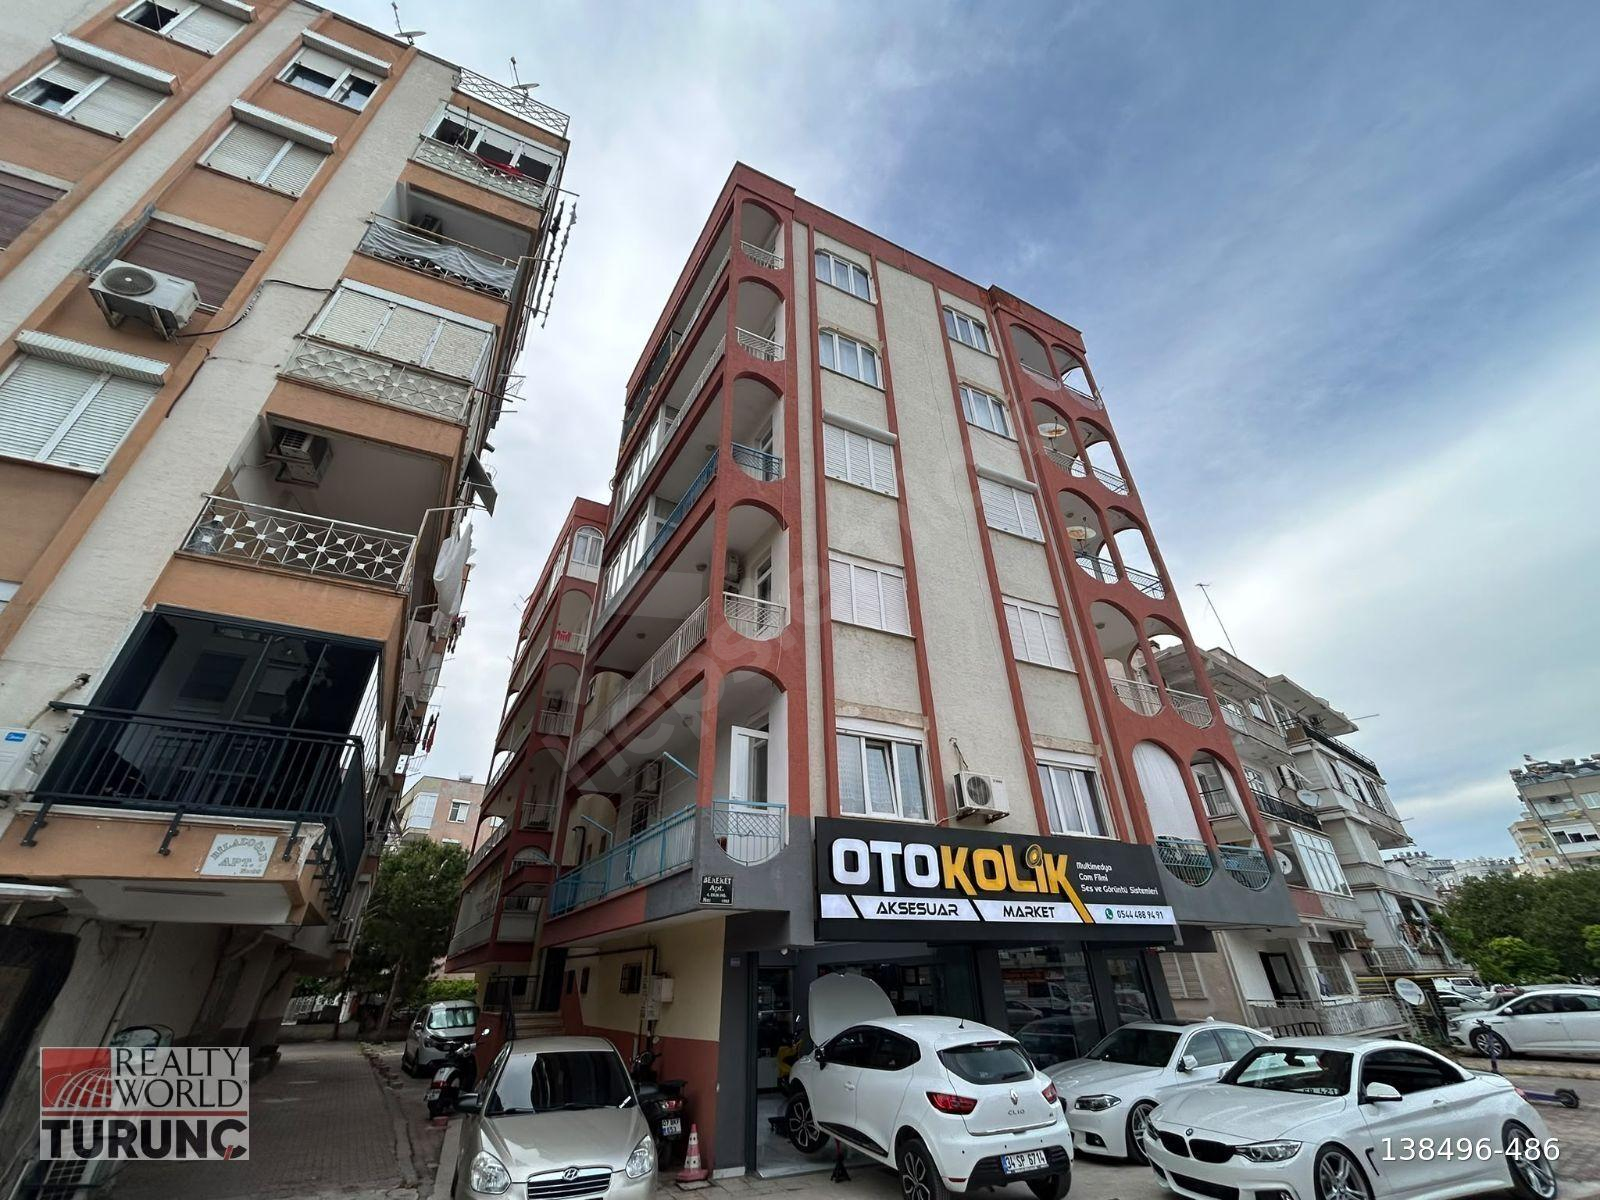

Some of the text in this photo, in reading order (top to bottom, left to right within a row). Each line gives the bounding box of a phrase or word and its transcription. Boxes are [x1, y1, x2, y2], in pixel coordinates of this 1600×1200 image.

[703, 876, 731, 884] BEREKET
[1078, 872, 1094, 882] Cam
[1080, 884, 1094, 893] Ses
[1129, 886, 1159, 896] Sistemleri
[876, 901, 1055, 918] AKSESUAR MARKET
[1005, 1151, 1046, 1169] 34 SP 6714
